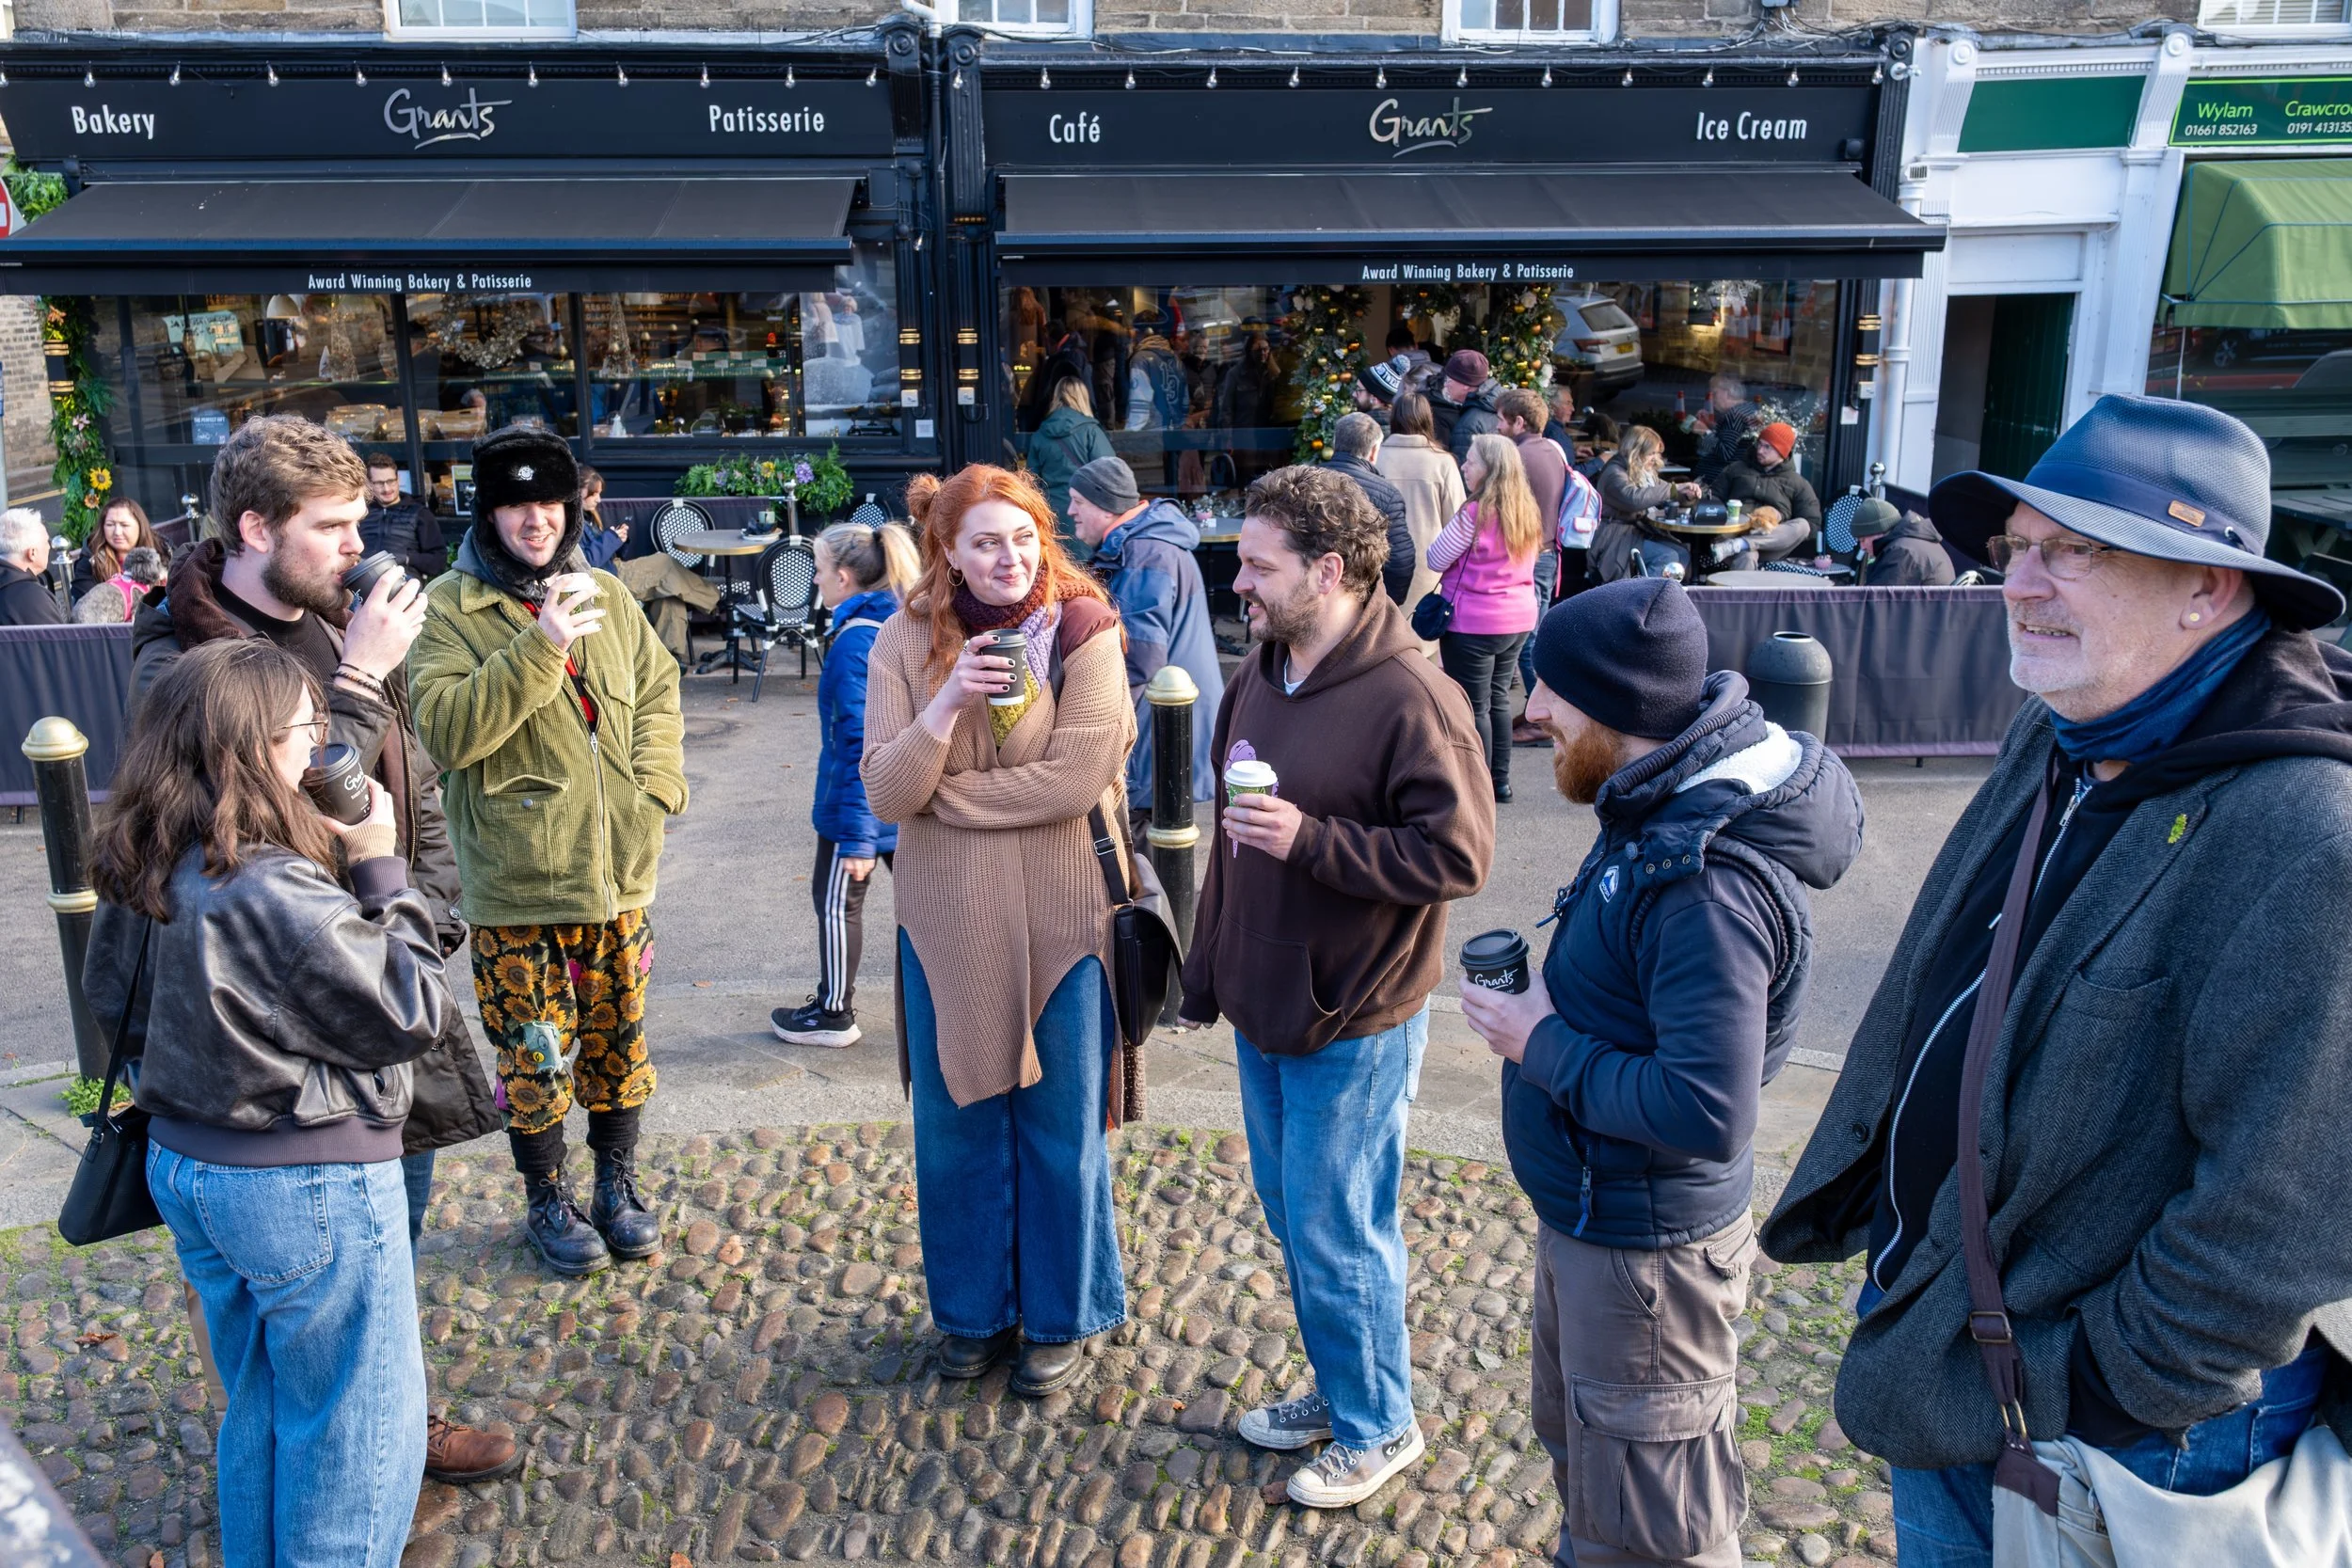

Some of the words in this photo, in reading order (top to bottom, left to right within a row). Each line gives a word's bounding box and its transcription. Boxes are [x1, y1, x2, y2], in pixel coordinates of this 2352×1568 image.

[384, 87, 512, 140] Grants
[708, 105, 825, 133] Patisserie
[2198, 102, 2253, 121] Wylam
[2285, 101, 2352, 117] Crawcro
[72, 104, 155, 139] Bakery
[1050, 112, 1101, 143] Café
[1370, 97, 1493, 148] Grants
[1696, 112, 1729, 140] Ice
[1737, 112, 1807, 140] Cream
[2185, 124, 2216, 136] 01661
[2217, 123, 2258, 135] 852163
[2287, 122, 2312, 135] 0191
[2314, 120, 2352, 134] 413135
[308, 274, 345, 289] Award
[351, 274, 403, 292] Winning
[408, 274, 451, 292] Bakery
[457, 274, 467, 289] &
[471, 273, 532, 289] Patisserie
[1362, 264, 1398, 280] Award
[1403, 264, 1452, 281] Winning
[1457, 263, 1497, 281] Bakery
[1502, 263, 1512, 278] &
[1517, 263, 1574, 278] Patisserie
[1474, 968, 1518, 989] Grants
